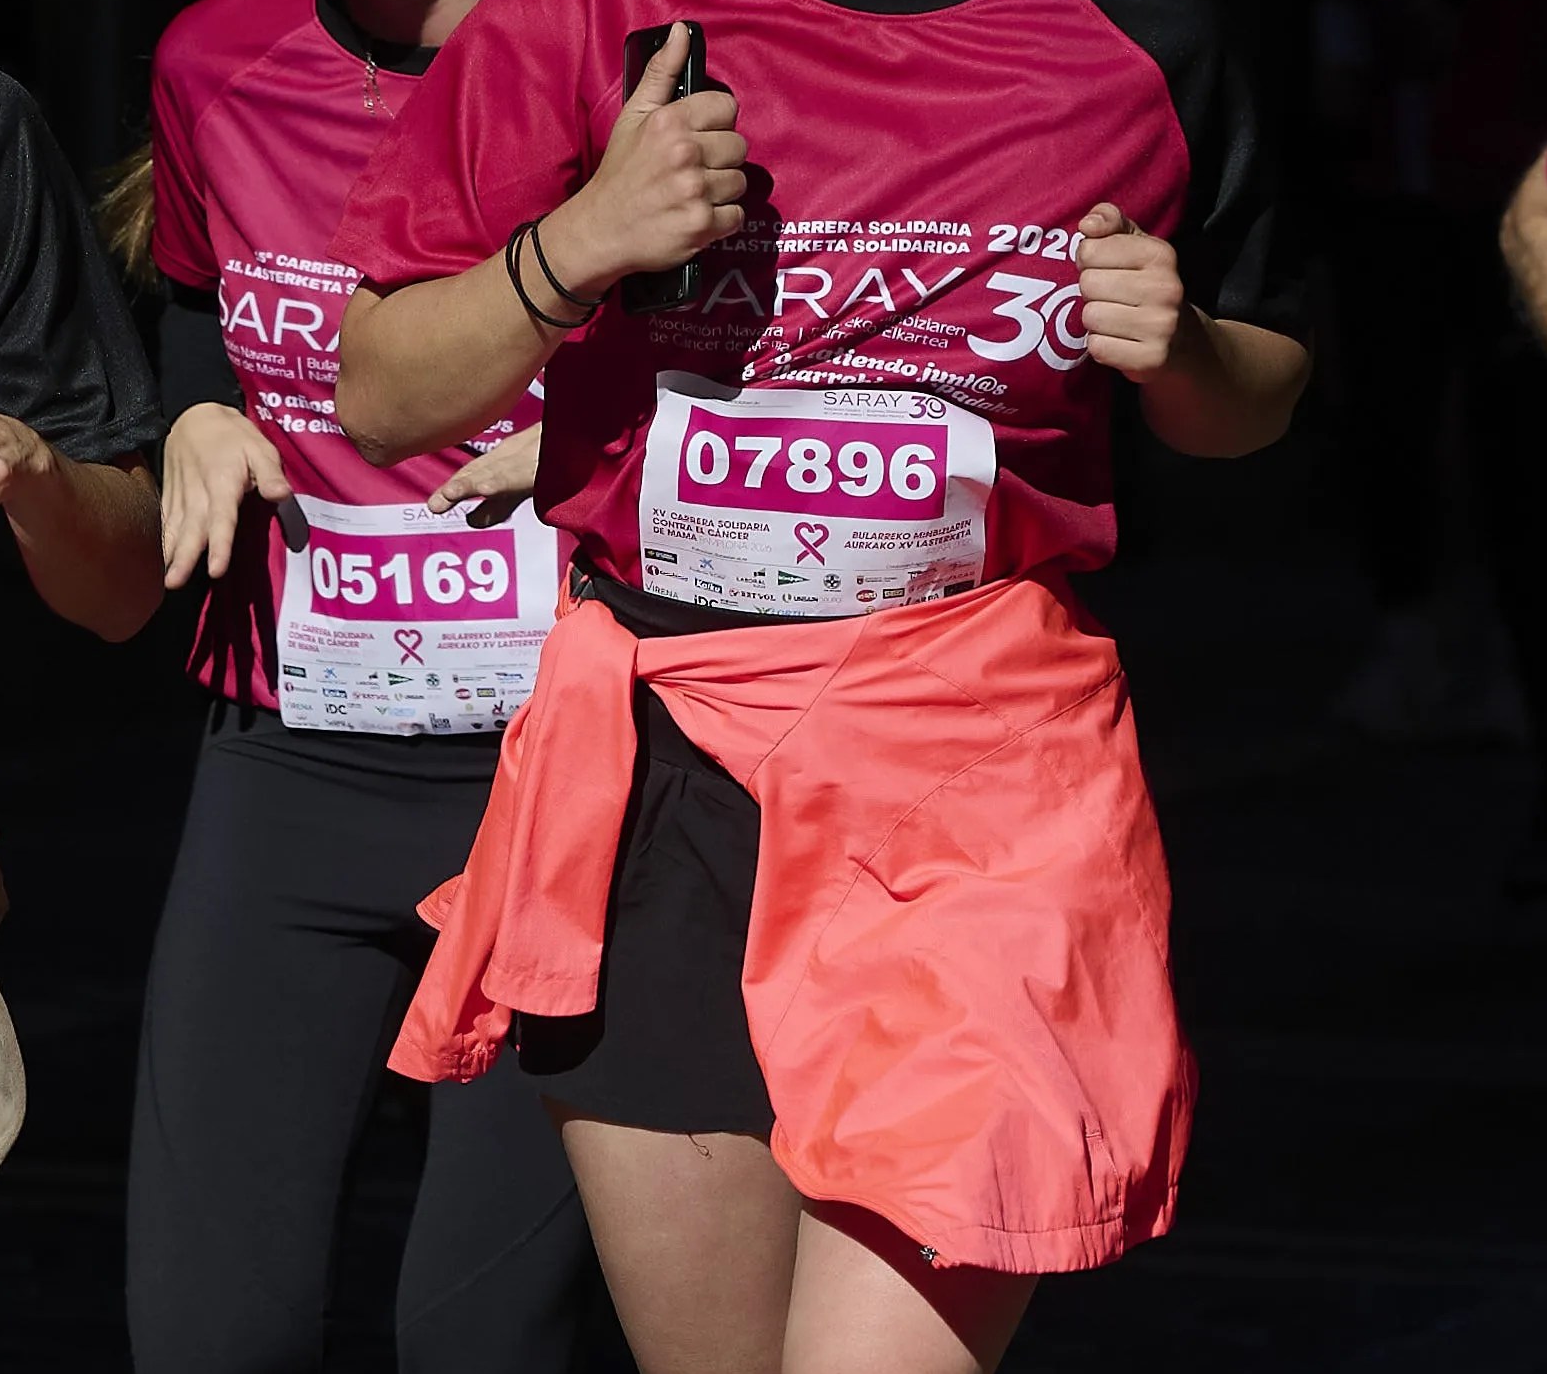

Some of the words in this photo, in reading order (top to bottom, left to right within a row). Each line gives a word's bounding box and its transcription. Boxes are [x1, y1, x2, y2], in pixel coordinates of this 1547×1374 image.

[772, 220, 864, 235] CARRERA
[867, 219, 973, 237] SOLIDARIA
[721, 238, 849, 254] LASTERKETA
[852, 238, 971, 255] SOLIDARIOA
[276, 254, 357, 278] CARRERA
[244, 263, 343, 294] LASTERKETA
[700, 266, 968, 319] ARAY
[917, 362, 1009, 397] junt@s
[823, 391, 903, 408] SARAY
[685, 429, 937, 501] 07896
[652, 507, 667, 517] XV
[717, 519, 771, 533] SOLIDARIA
[652, 516, 694, 532] CONTRA
[653, 527, 665, 536] DE
[666, 529, 698, 542] MAMA
[851, 530, 912, 541] BULARREKO
[843, 540, 896, 551] AURKAKO
[898, 540, 915, 550] XV
[311, 546, 510, 605] 05169
